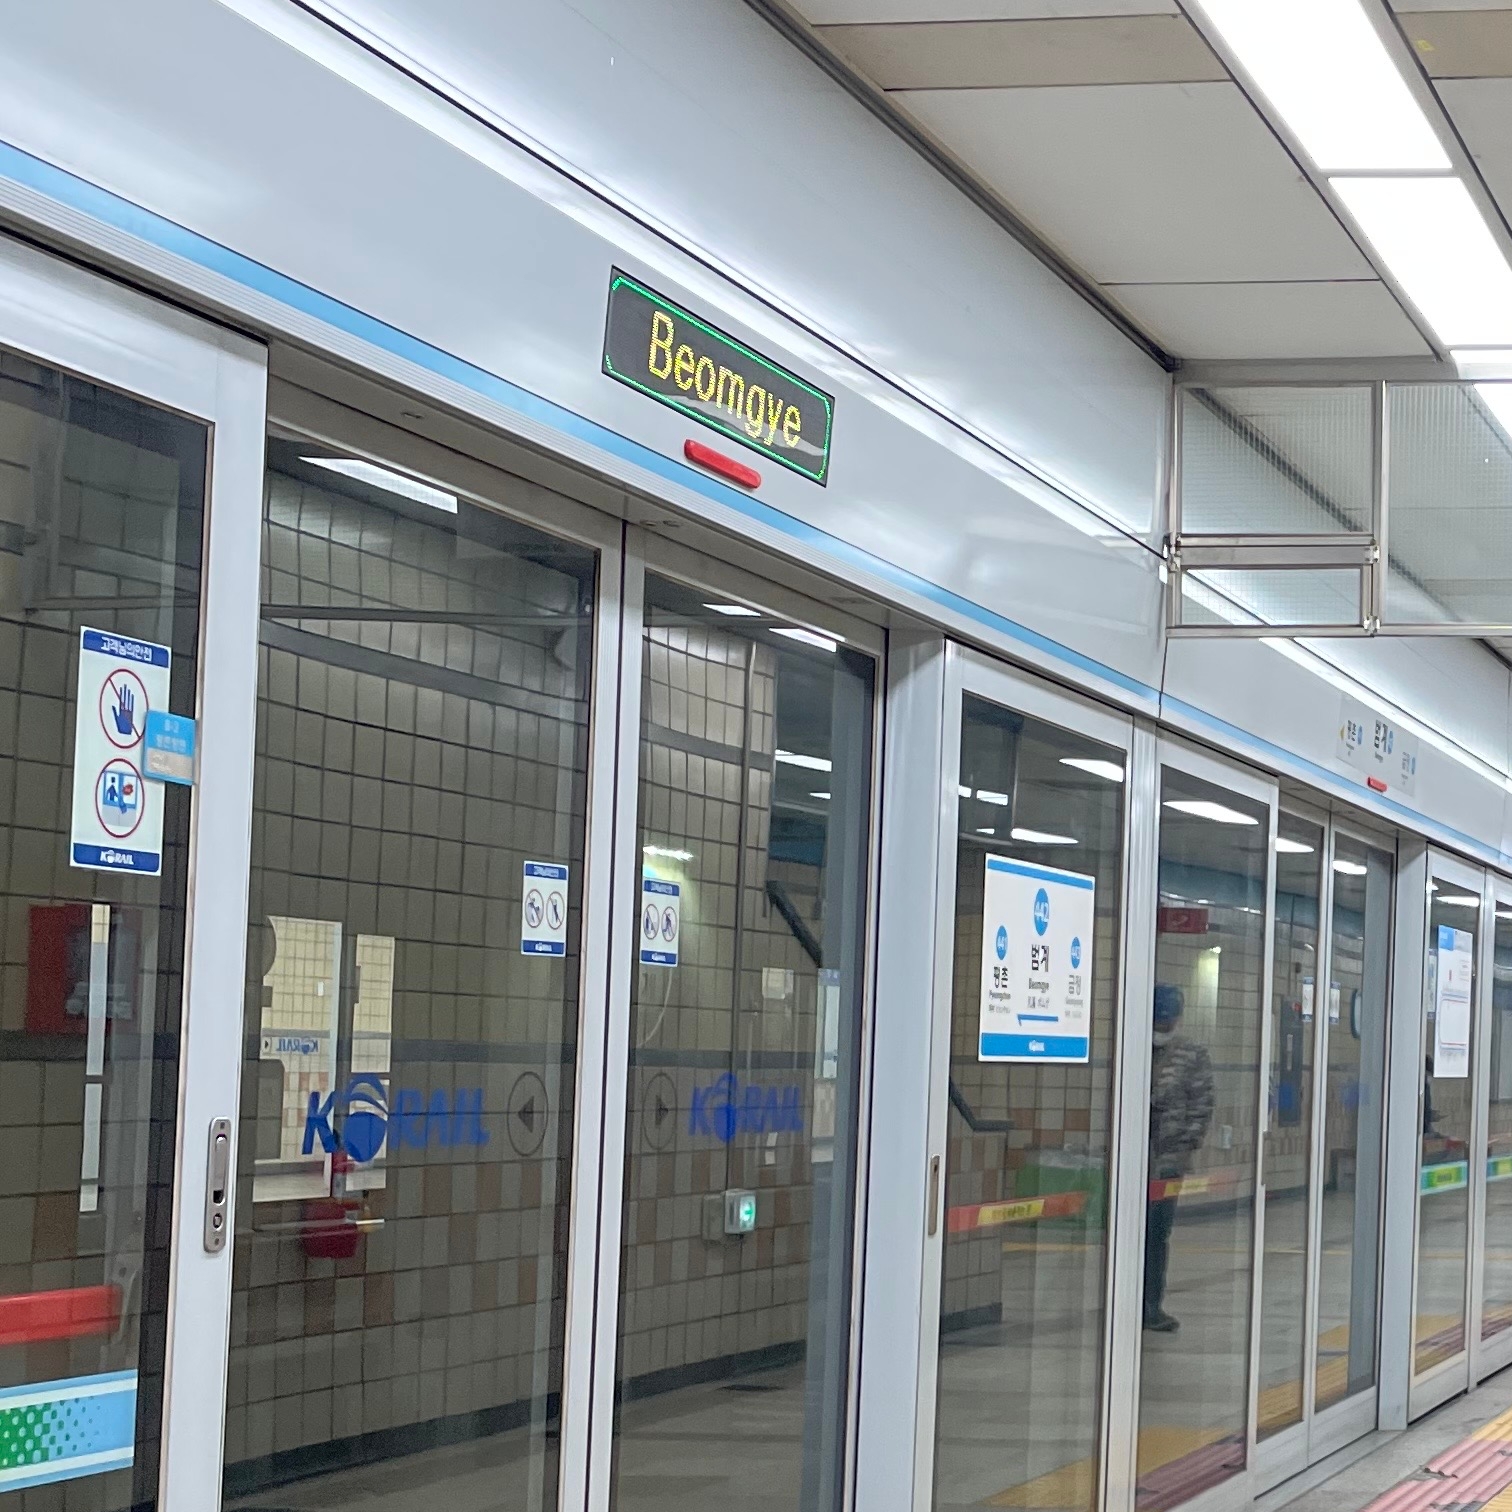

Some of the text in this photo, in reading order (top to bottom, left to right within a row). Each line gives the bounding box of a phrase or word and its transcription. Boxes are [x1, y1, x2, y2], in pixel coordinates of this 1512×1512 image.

[648, 310, 801, 448] Beomgye
[100, 849, 135, 865] KORAIL
[302, 1072, 491, 1163] KORAIL
